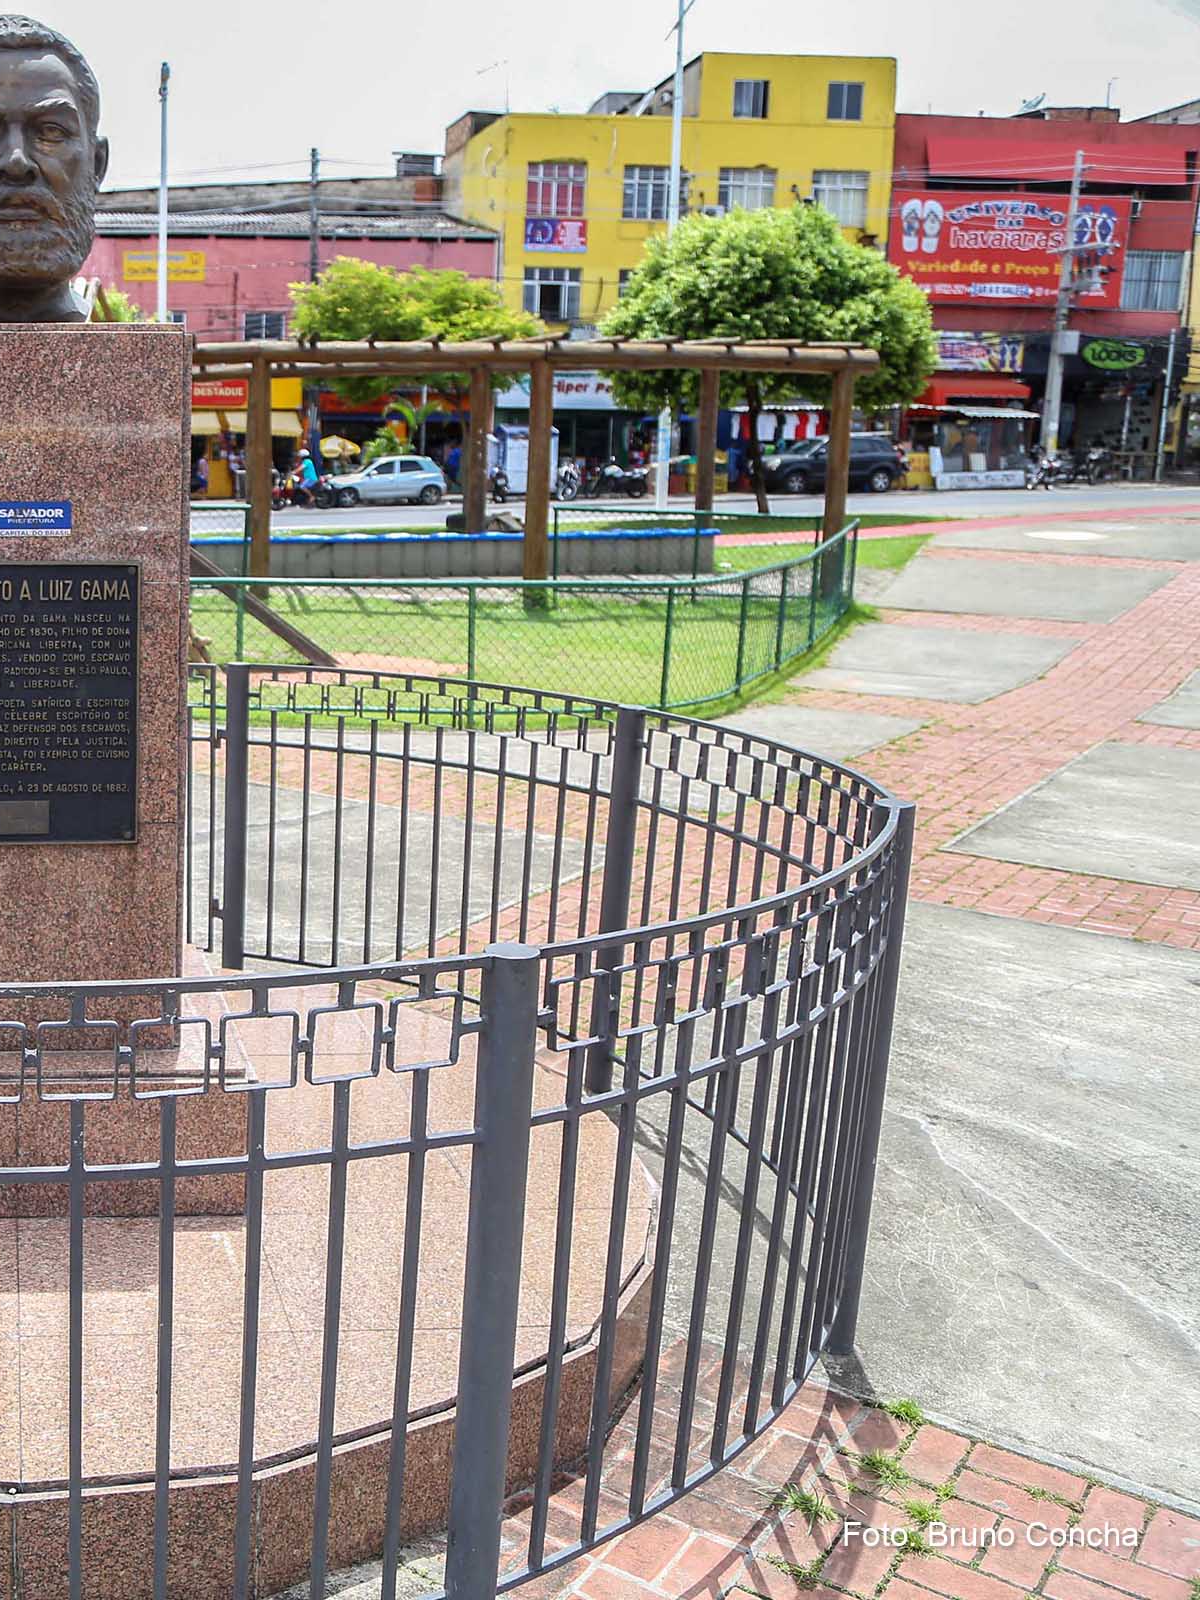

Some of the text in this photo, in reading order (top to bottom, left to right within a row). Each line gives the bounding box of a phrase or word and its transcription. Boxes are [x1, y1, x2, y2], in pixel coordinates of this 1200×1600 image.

[945, 200, 1066, 226] UNIVERSO
[996, 218, 1024, 229] DAS
[950, 227, 1065, 250] havaianas
[907, 259, 987, 273] Variedade
[992, 264, 1000, 273] e
[1006, 263, 1049, 276] Preço
[0, 509, 64, 518] SALVADOR
[20, 580, 32, 601] A
[40, 580, 73, 601] LUIZ
[80, 580, 131, 601] GAMA
[23, 614, 35, 623] DA
[42, 614, 66, 623] GAMA
[74, 614, 112, 623] NASCEU
[118, 614, 130, 623] NA
[15, 627, 28, 636] DE
[30, 627, 58, 637] 1830,
[62, 627, 88, 636] FILHO
[92, 627, 103, 636] DE
[107, 627, 130, 636] DONA
[40, 640, 82, 652] LIBERTA,
[91, 640, 110, 649] COM
[118, 640, 131, 649] UM
[63, 653, 85, 662] COMO
[91, 653, 130, 662] ESCRAVO
[64, 666, 75, 675] EM
[9, 680, 15, 688] A
[24, 680, 78, 688] LIBERDADE.
[32, 697, 71, 707] SATÍRICO
[76, 699, 81, 707] E
[87, 699, 129, 707] ESCRITOR
[5, 709, 48, 721] CÉLEBRE
[56, 709, 110, 720] ESCRITÓRIO
[118, 711, 129, 720] DE
[13, 724, 56, 732] DEFENSOR
[60, 724, 77, 732] DOS
[82, 724, 130, 734] ESCRAVOS,
[4, 738, 39, 746] DIREITO
[45, 737, 50, 745] E
[56, 737, 80, 745] PELA
[23, 750, 36, 758] FOI
[40, 750, 78, 758] EXEMPLO
[82, 750, 94, 758] DE
[97, 750, 130, 758] CIVISMO
[1, 760, 47, 772] CARÁTER.
[27, 784, 38, 792] 23
[42, 784, 53, 792] DE
[56, 784, 89, 792] AGOSTO
[92, 784, 102, 792] DE
